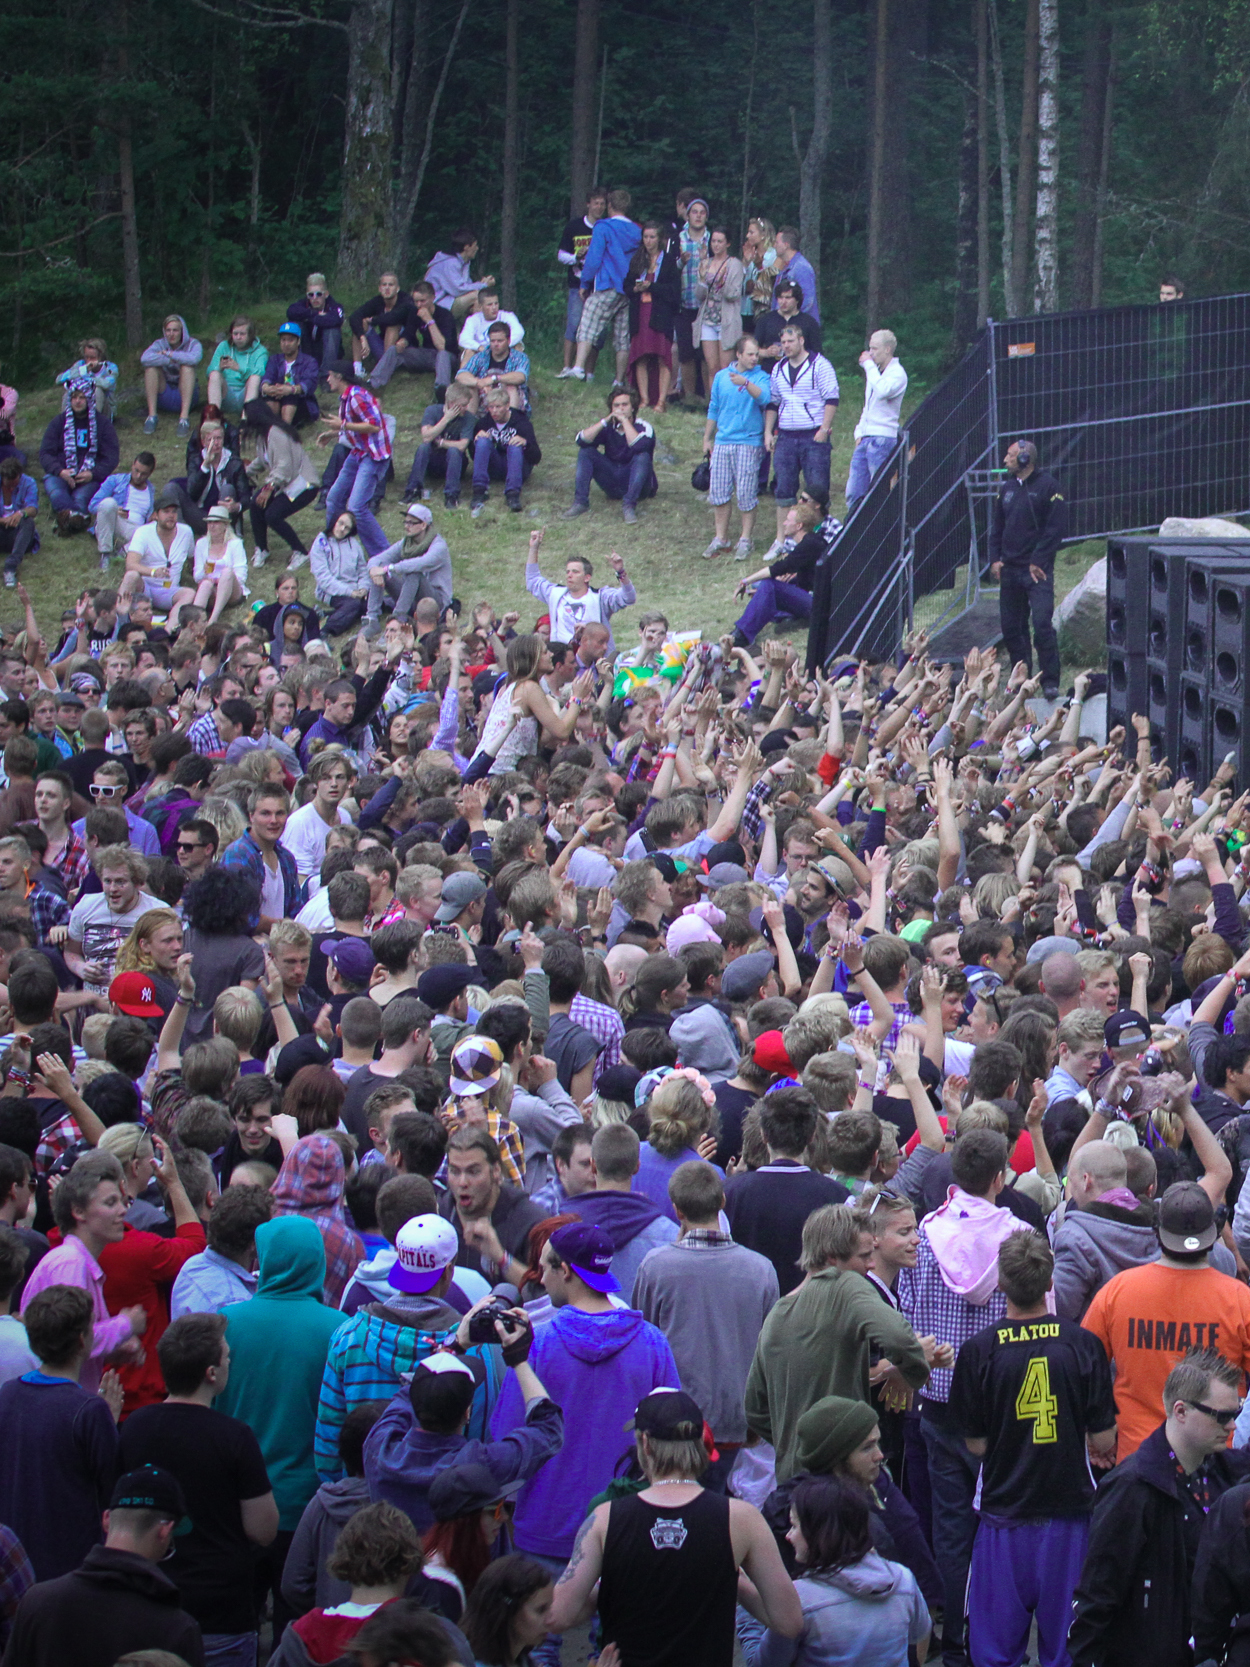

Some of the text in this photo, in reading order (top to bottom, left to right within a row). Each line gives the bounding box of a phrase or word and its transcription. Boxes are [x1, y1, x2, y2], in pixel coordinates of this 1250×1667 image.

[398, 1248, 436, 1269] PITALS
[997, 1323, 1060, 1345] PLATOU
[1127, 1317, 1220, 1352] INMATE
[1015, 1356, 1058, 1444] 4
